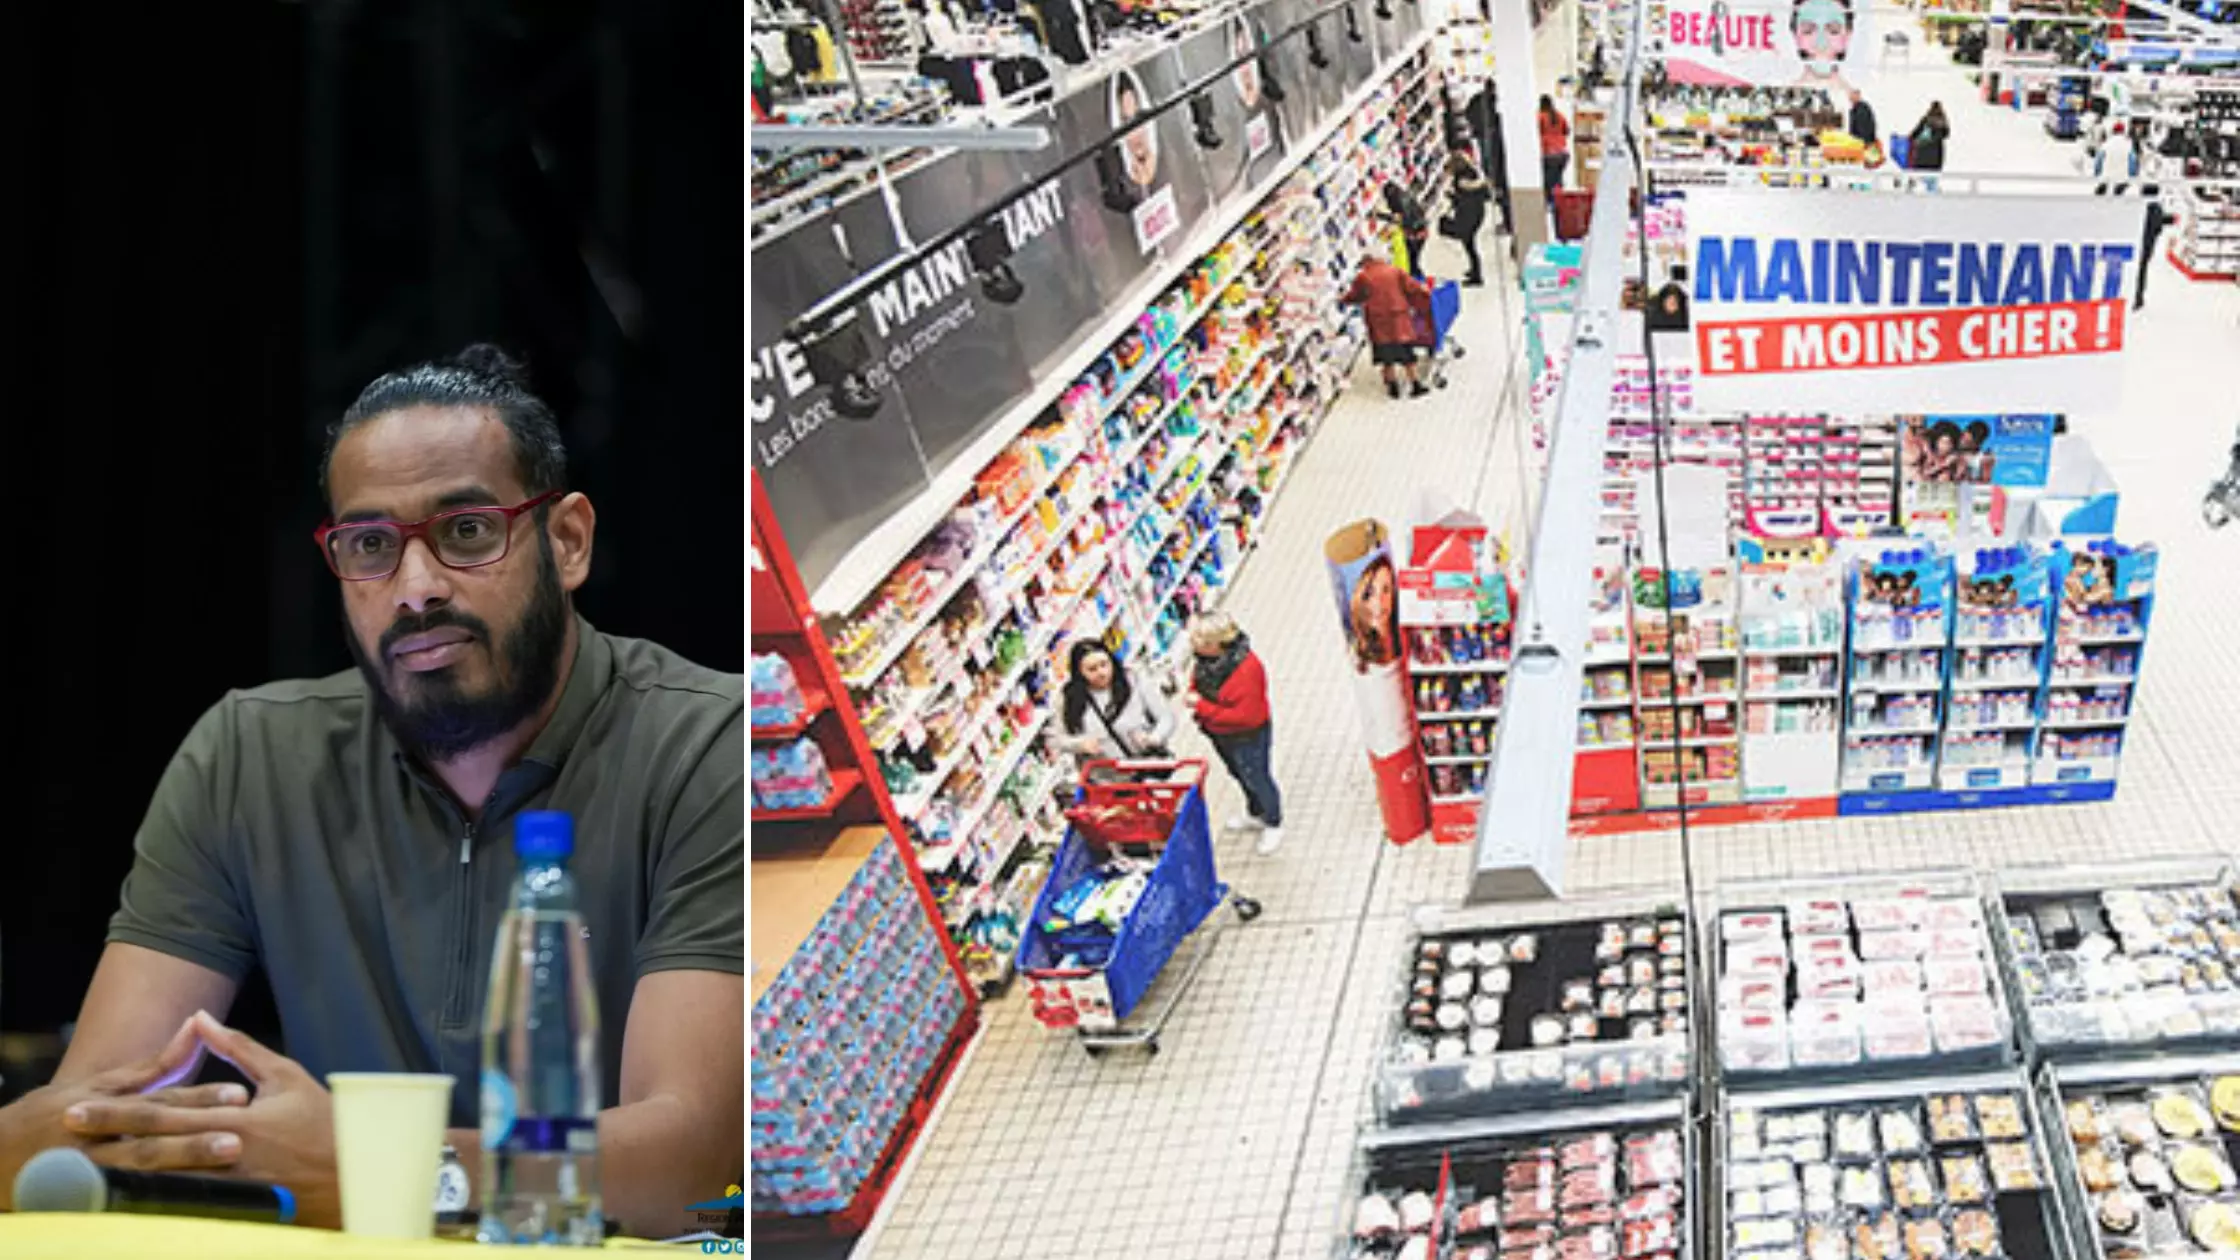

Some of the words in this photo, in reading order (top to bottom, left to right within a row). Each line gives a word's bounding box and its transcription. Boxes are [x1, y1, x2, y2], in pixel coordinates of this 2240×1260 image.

[1695, 237, 2134, 306] MAINTENANT
[1709, 325, 1763, 371] ET
[1785, 318, 1941, 369] MOINS
[1958, 310, 2078, 357] CHER
[2096, 303, 2111, 346] !
[757, 428, 794, 467] Les
